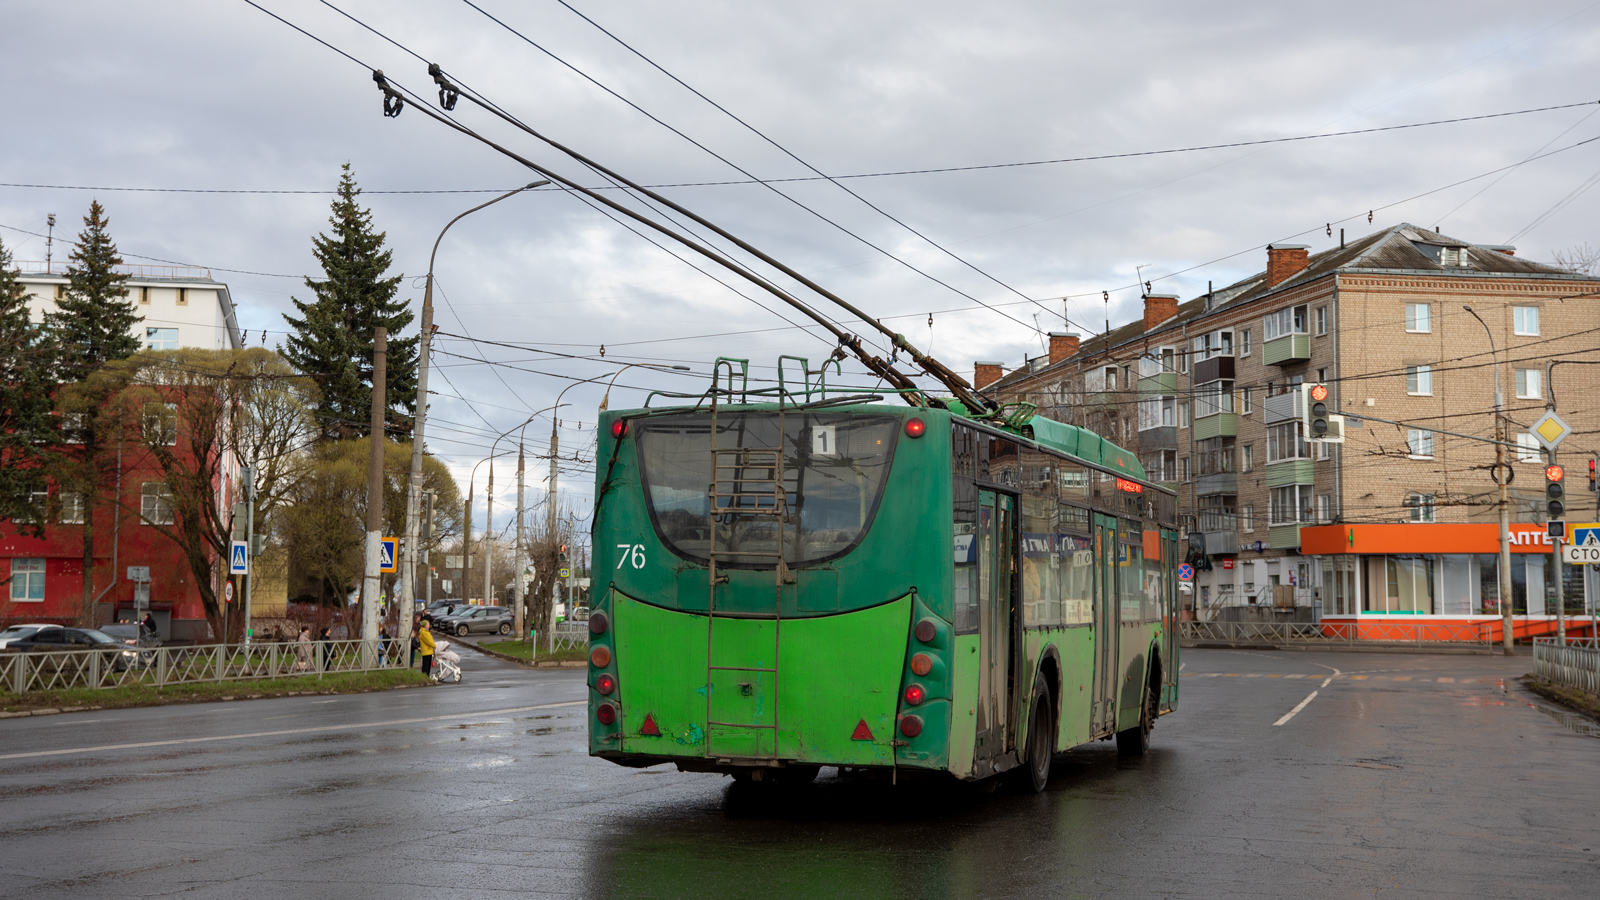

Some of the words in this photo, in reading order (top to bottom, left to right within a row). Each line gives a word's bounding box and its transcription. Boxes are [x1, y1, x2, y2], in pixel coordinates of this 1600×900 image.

[818, 431, 827, 452] 1
[1508, 531, 1570, 545] АПТЕ
[616, 544, 646, 570] 76
